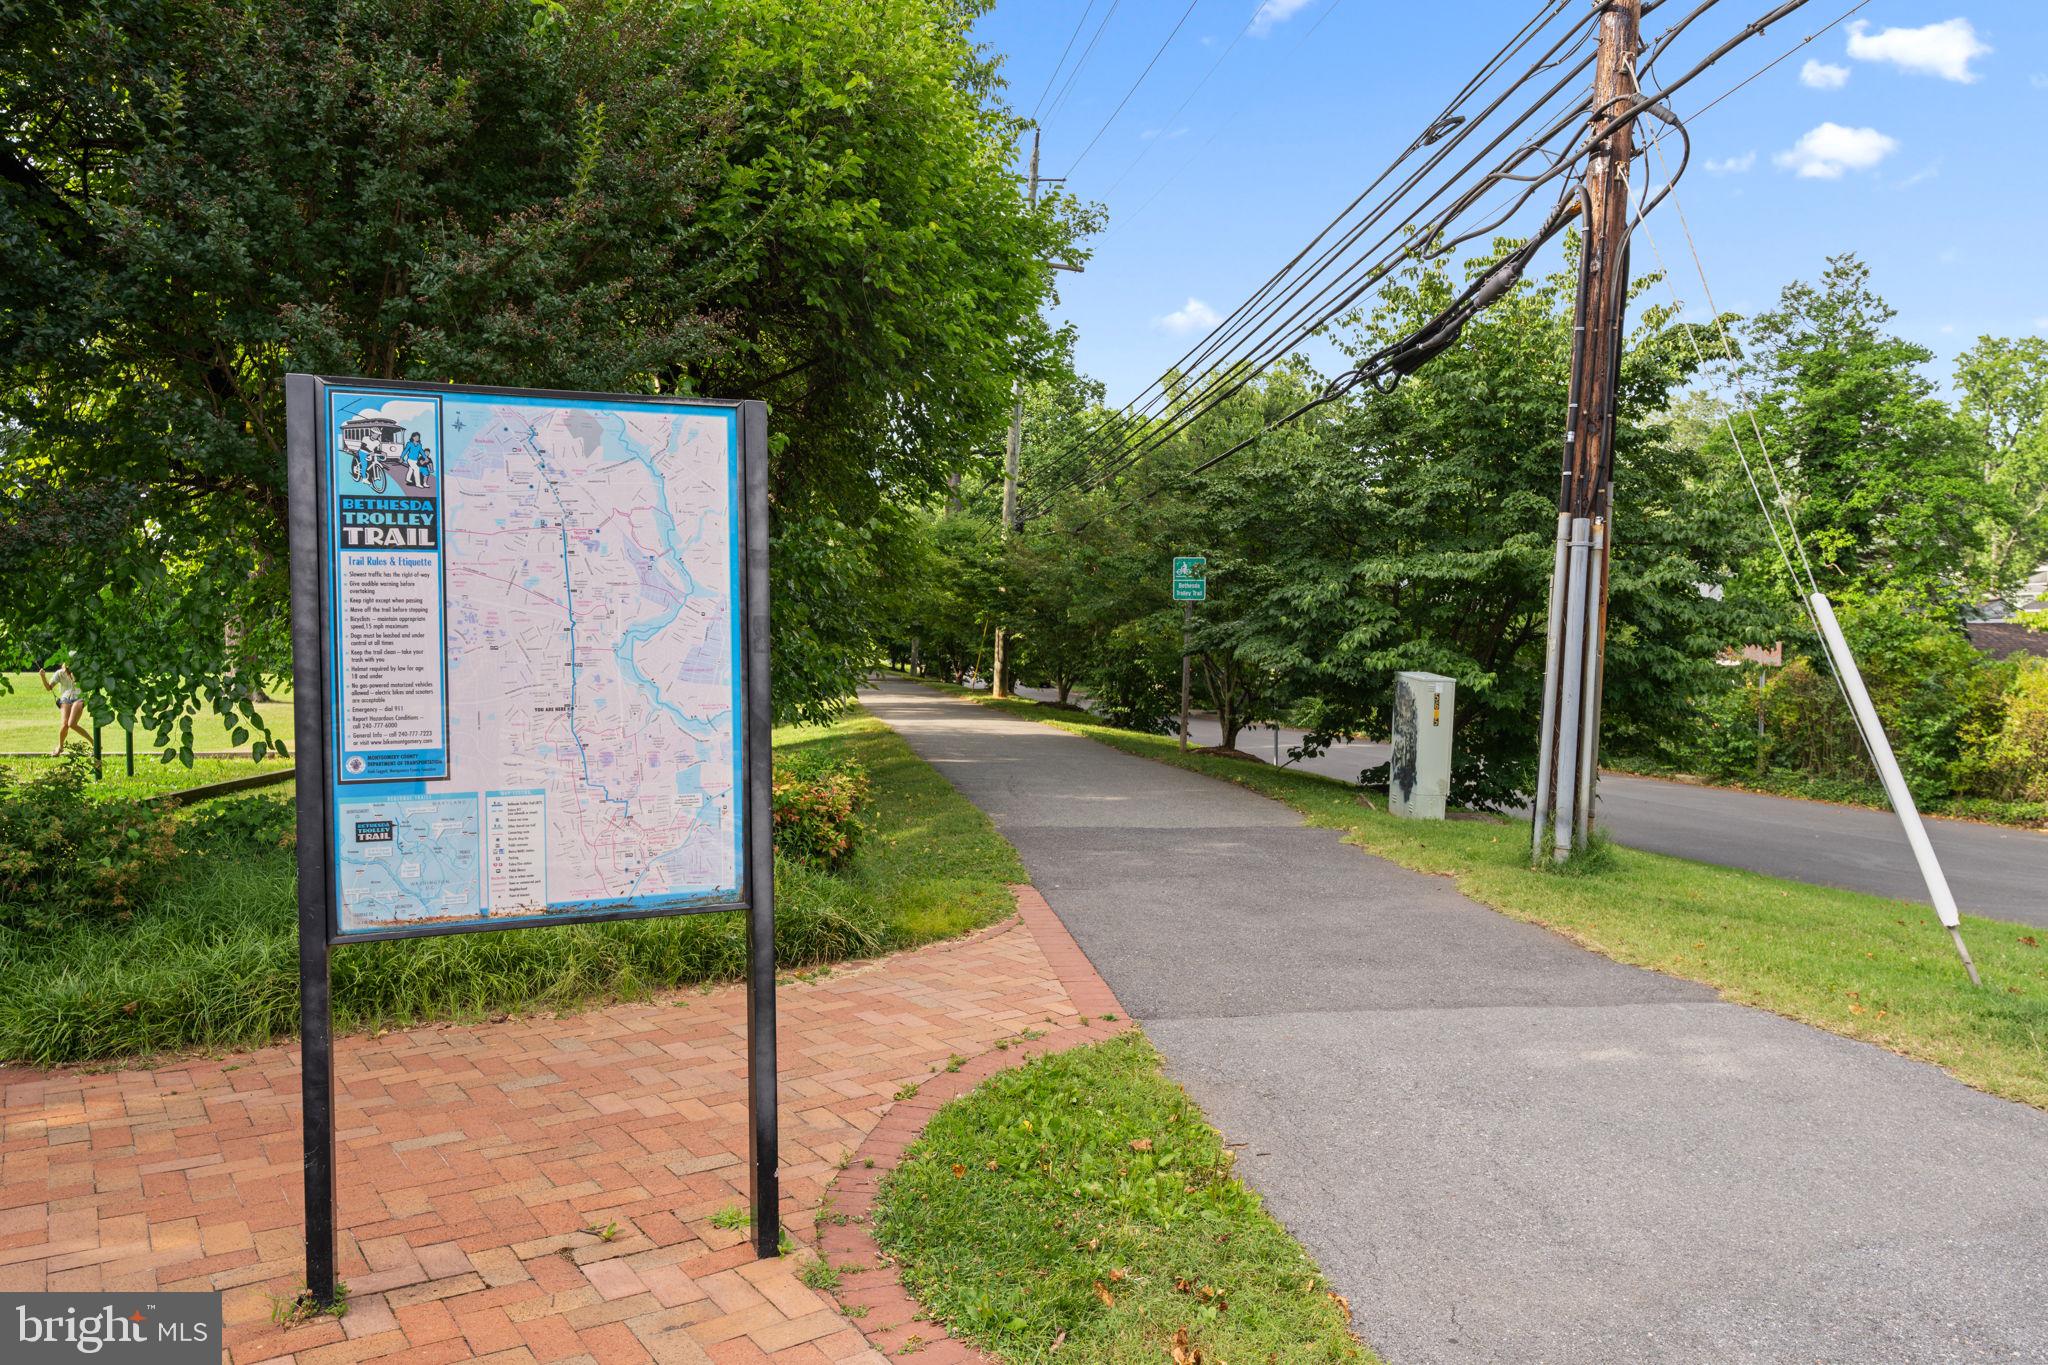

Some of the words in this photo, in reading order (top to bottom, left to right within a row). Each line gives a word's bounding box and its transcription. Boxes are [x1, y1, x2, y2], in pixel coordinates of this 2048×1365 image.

[342, 498, 433, 511] BETHESDA
[342, 512, 434, 525] TROLLEY
[342, 527, 435, 546] TRAIL
[348, 556, 364, 566] Trail
[367, 556, 387, 566] Rules
[389, 557, 395, 566] &
[398, 557, 432, 568] Etiquette
[357, 832, 391, 840] TRAIL
